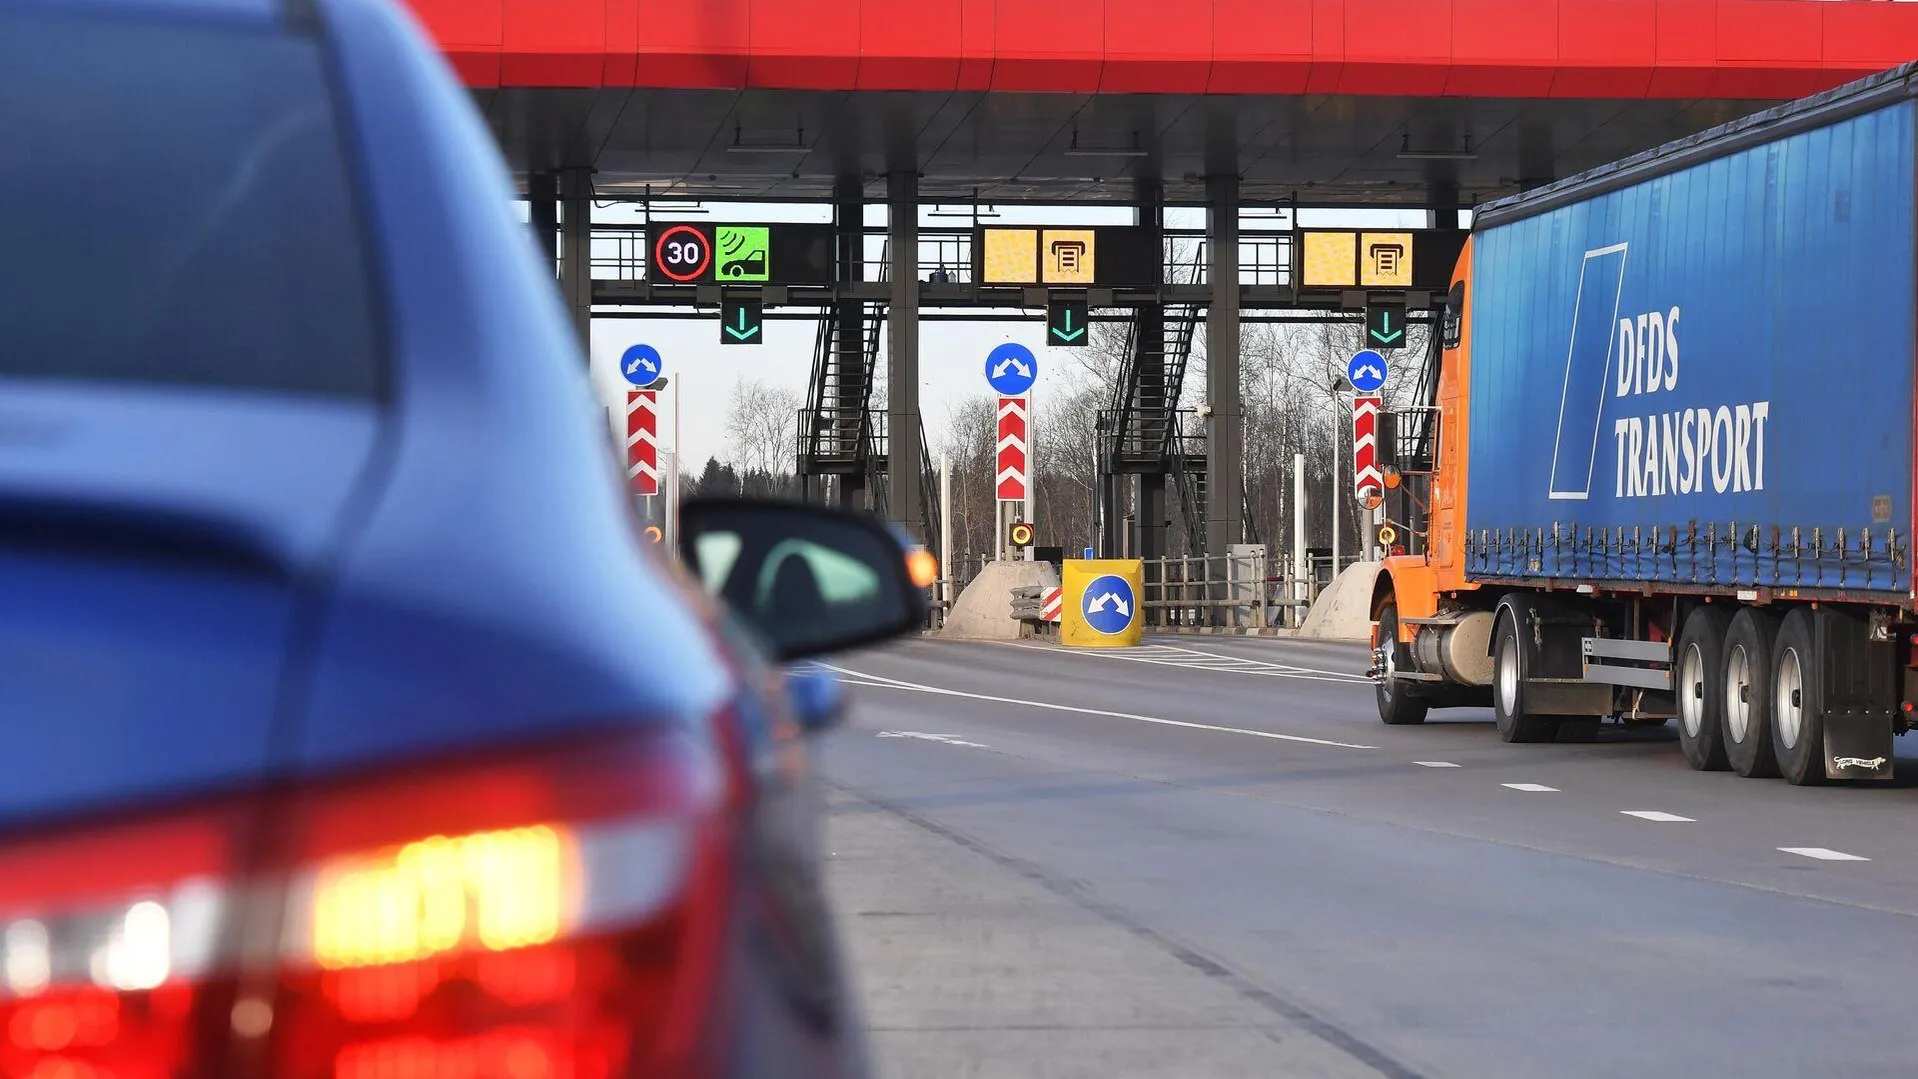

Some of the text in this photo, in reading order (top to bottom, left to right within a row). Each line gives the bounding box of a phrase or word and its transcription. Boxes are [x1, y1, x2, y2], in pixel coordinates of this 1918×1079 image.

[667, 242, 699, 264] 30
[1616, 306, 1680, 397] DFDS
[1614, 401, 1770, 498] TRANSPORT
